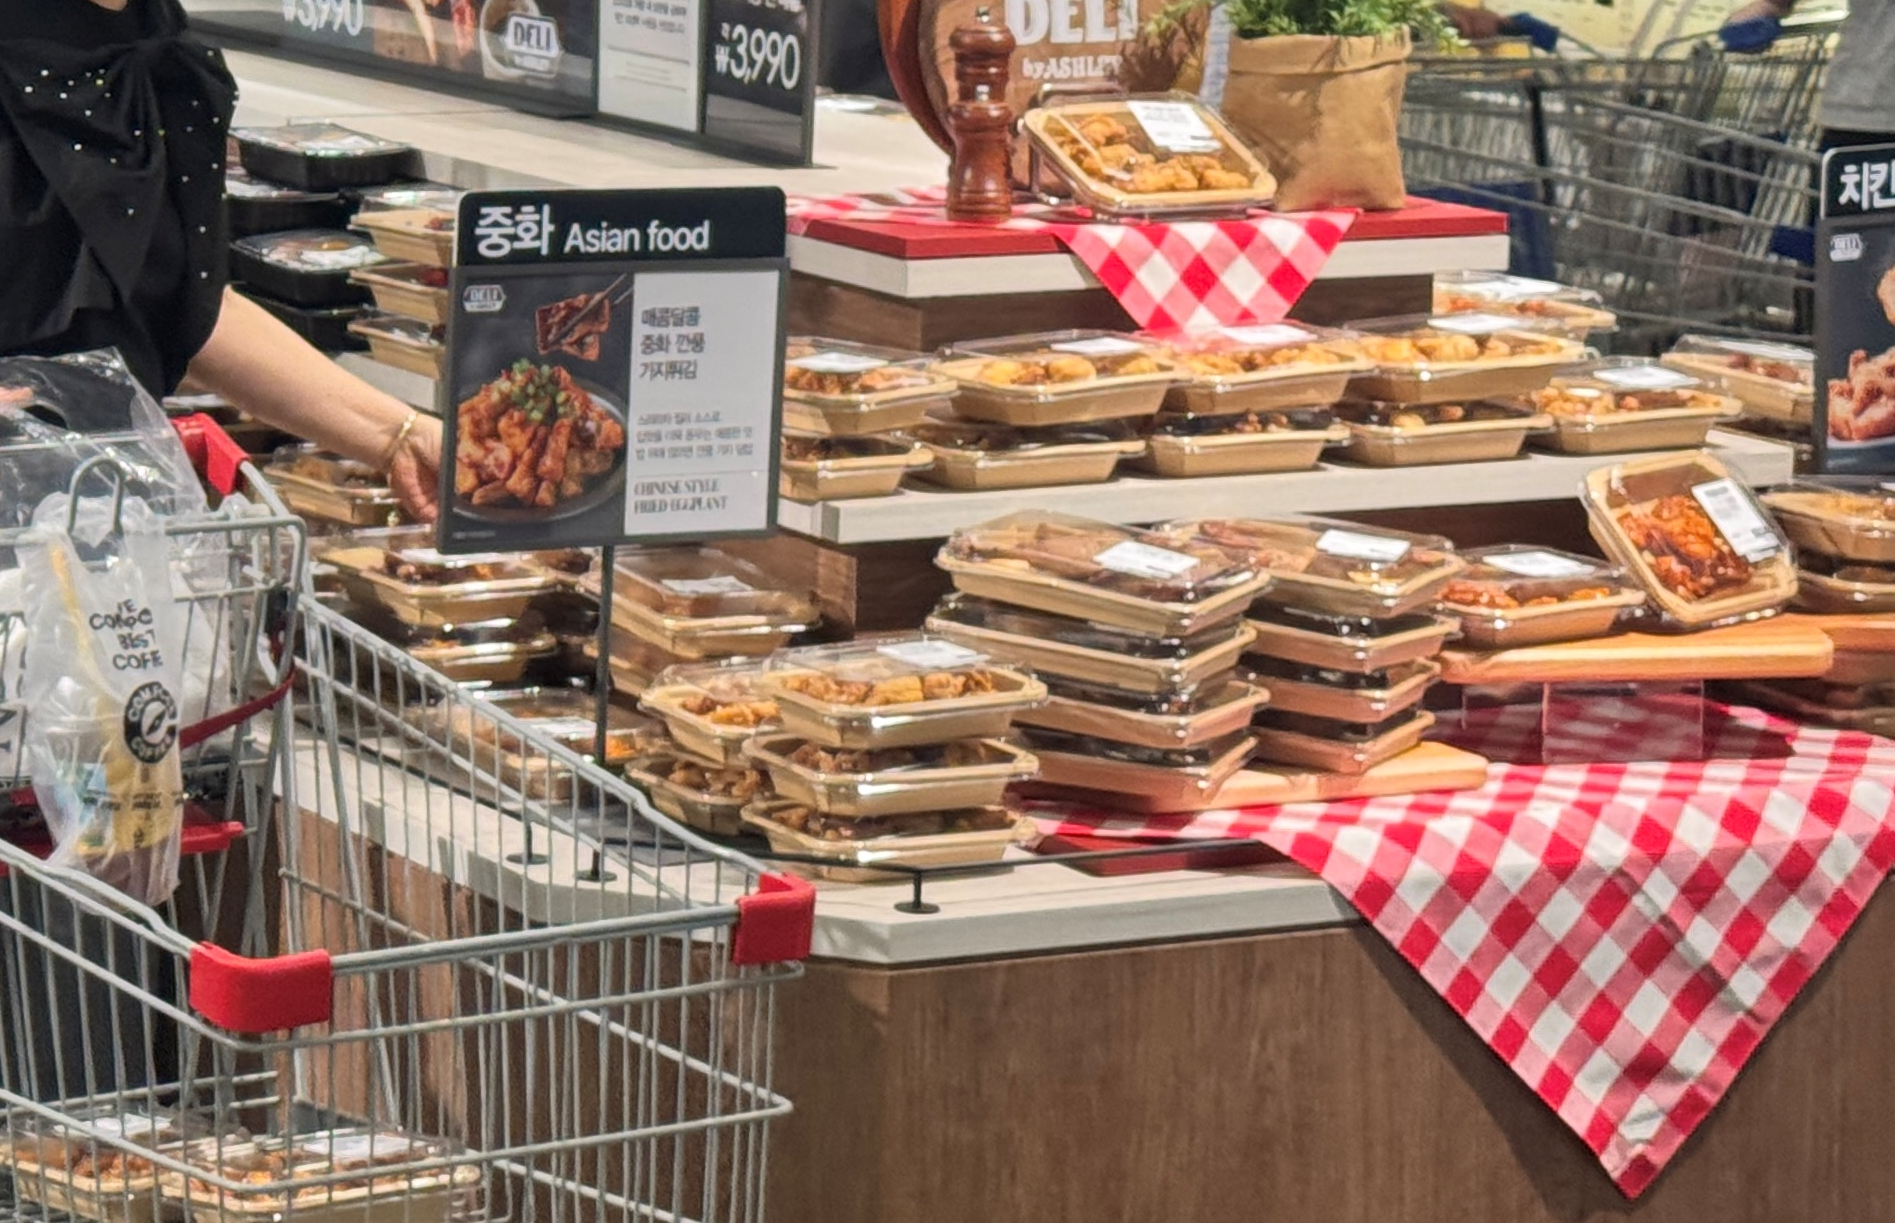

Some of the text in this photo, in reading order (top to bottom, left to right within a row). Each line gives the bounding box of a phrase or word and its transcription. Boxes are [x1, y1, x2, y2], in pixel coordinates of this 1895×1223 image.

[513, 21, 551, 52] DELI
[475, 204, 711, 258] 중화 Asian food
[640, 333, 671, 356] 중화
